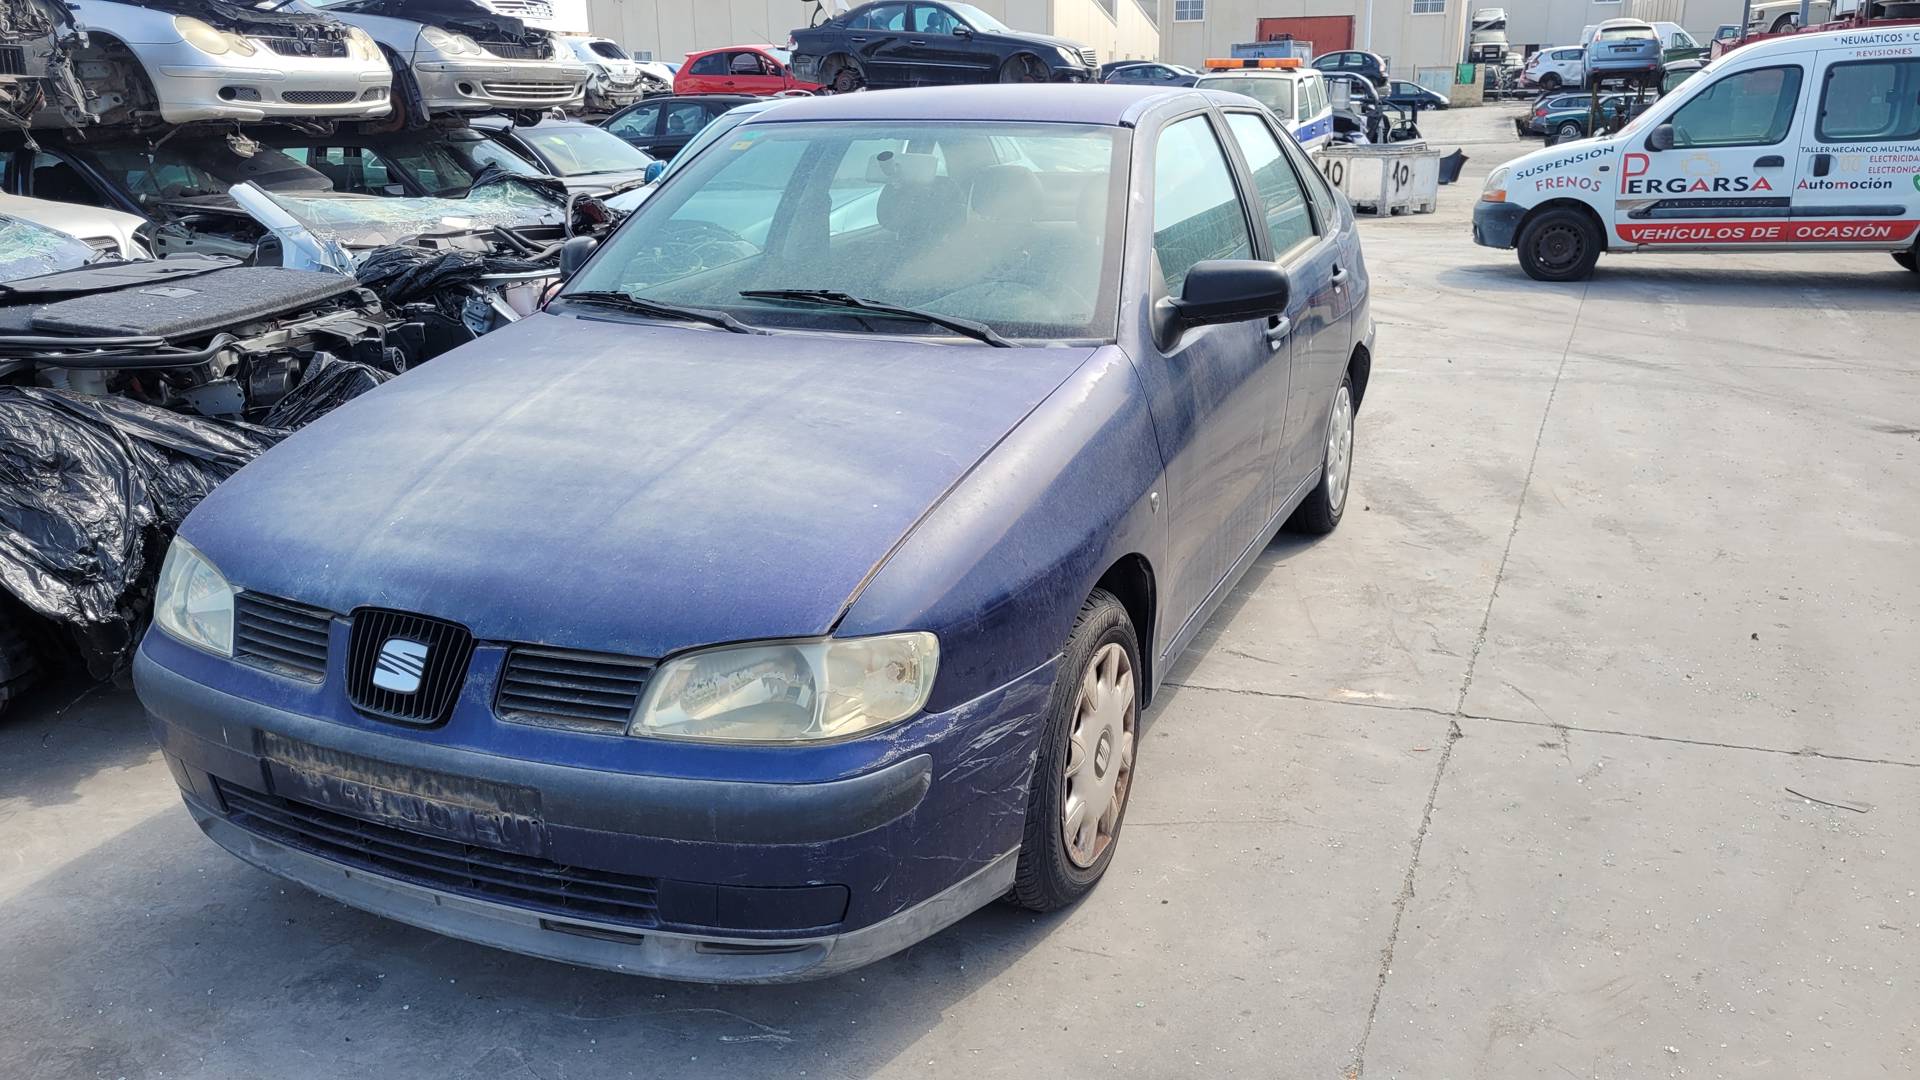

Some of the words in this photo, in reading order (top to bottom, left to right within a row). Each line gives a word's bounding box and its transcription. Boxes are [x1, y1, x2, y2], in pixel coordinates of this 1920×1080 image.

[1856, 48, 1913, 57] REVISIONES
[1516, 145, 1615, 180] SUSPENSION
[1392, 160, 1409, 192] 10
[1621, 153, 1773, 194] PERGARSA
[1535, 176, 1601, 192] FRENOS
[1797, 177, 1892, 190] Automoción
[1631, 226, 1745, 240] VEHÍCULOS
[1751, 226, 1780, 238] DE
[1796, 224, 1891, 238] OCASIÓN
